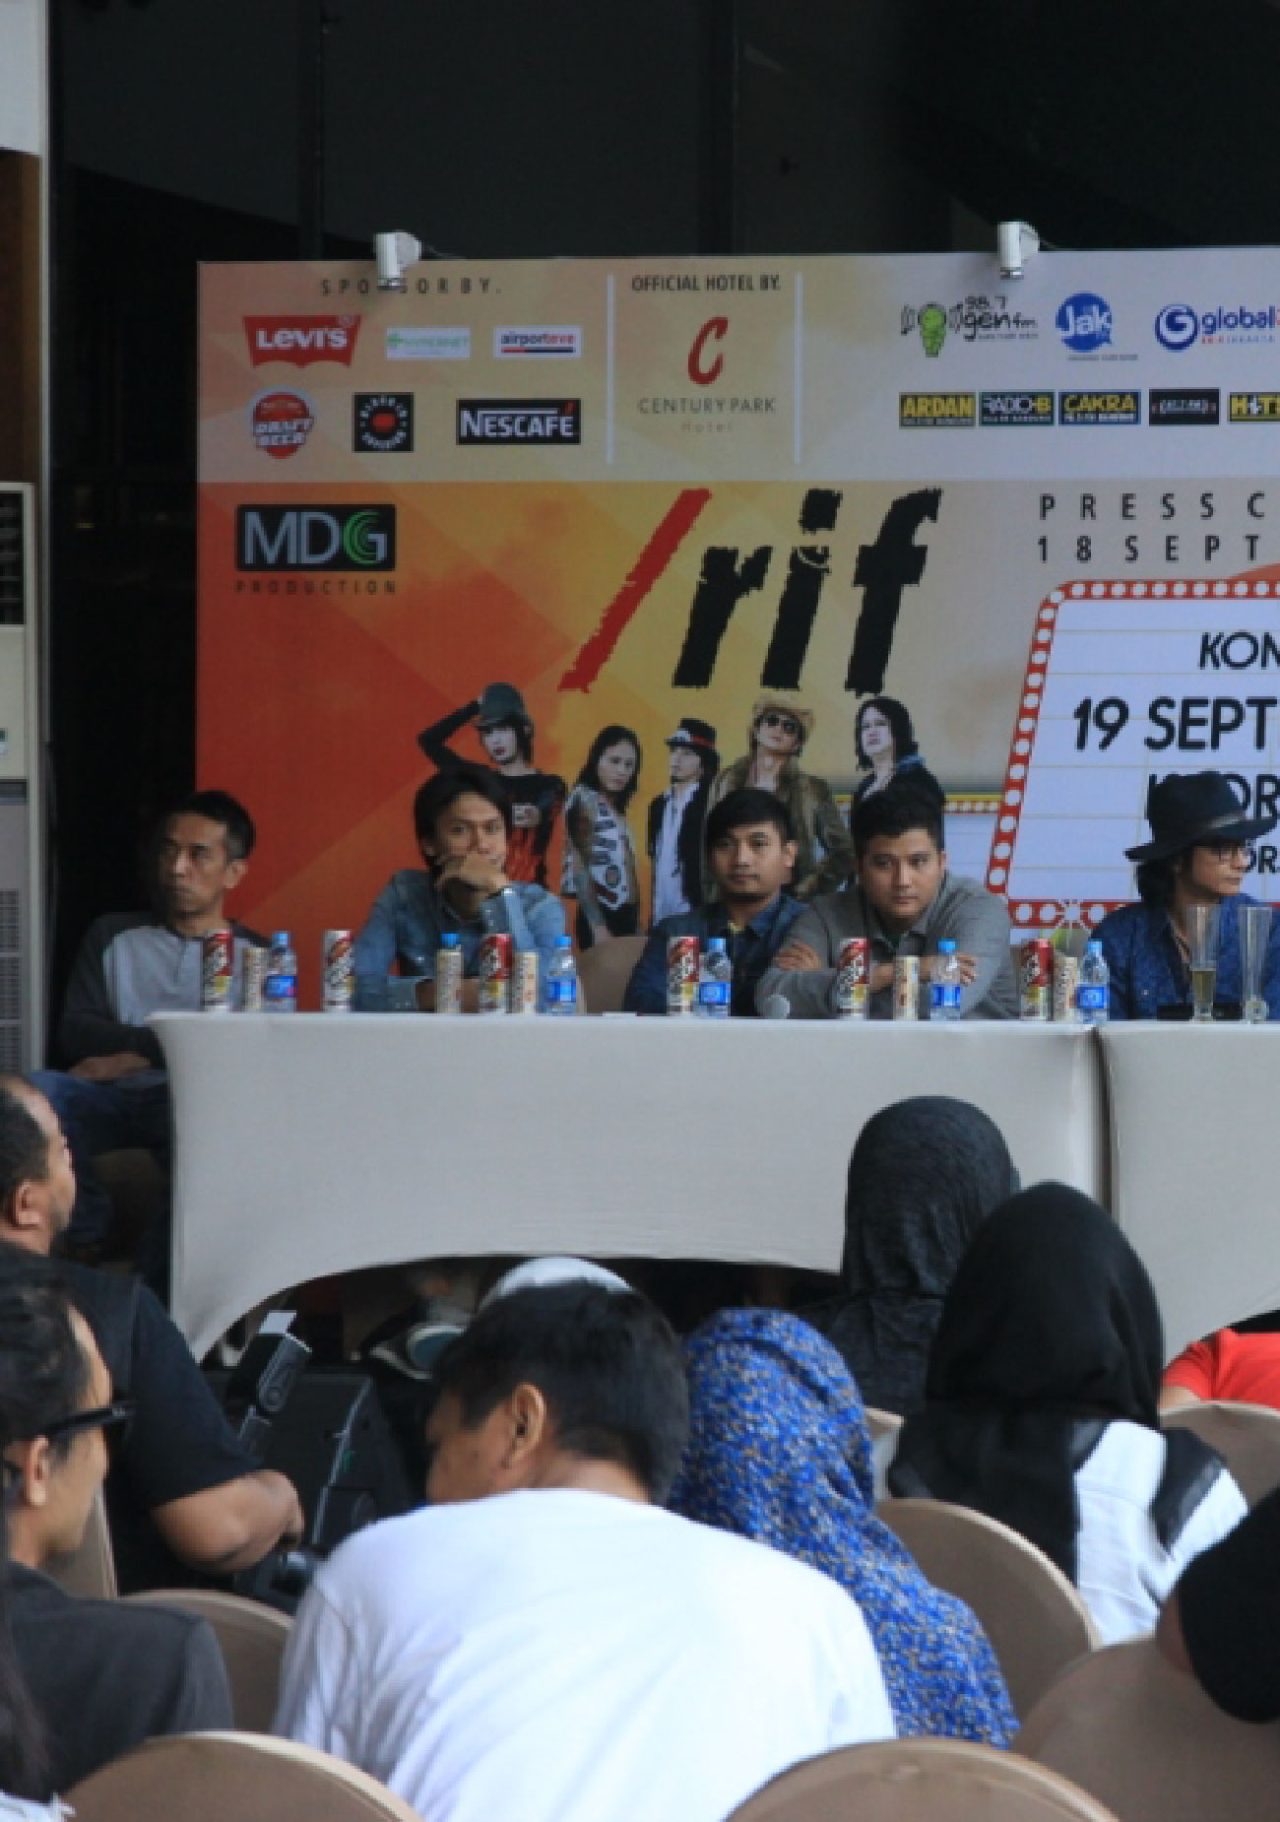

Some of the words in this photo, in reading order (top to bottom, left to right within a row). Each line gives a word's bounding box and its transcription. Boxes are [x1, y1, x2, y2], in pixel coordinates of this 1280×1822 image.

[321, 278, 449, 295] SPOSOR
[632, 274, 700, 292] OFFICIAL
[706, 273, 754, 291] HOTEL
[638, 397, 724, 415] CENTURY
[729, 397, 777, 413] PARK
[1040, 493, 1216, 521] PRESS
[1037, 533, 1093, 563] 18
[235, 580, 396, 595] PRODUCTION
[1072, 696, 1130, 752] 19
